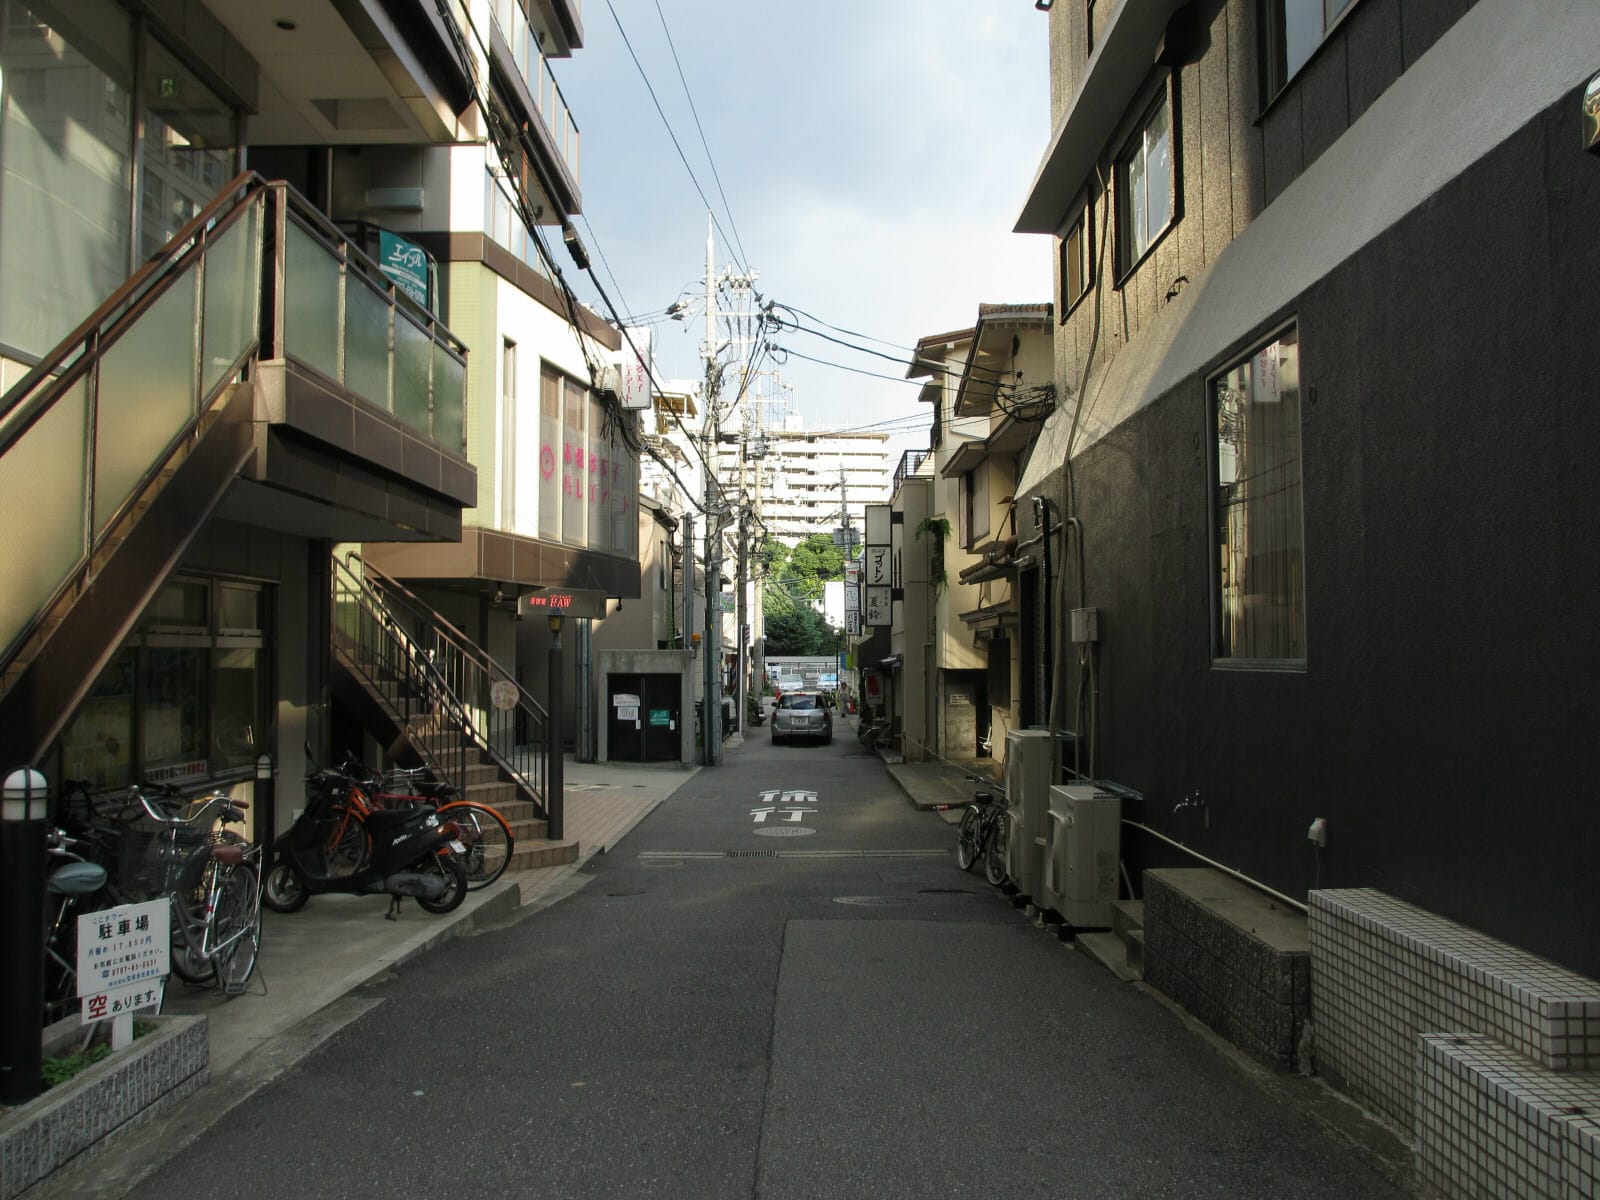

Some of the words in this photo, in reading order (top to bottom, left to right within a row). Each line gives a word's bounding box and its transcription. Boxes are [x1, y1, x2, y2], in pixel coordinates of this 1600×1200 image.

[98, 914, 150, 940] 駐車場
[87, 994, 108, 1020] 空
